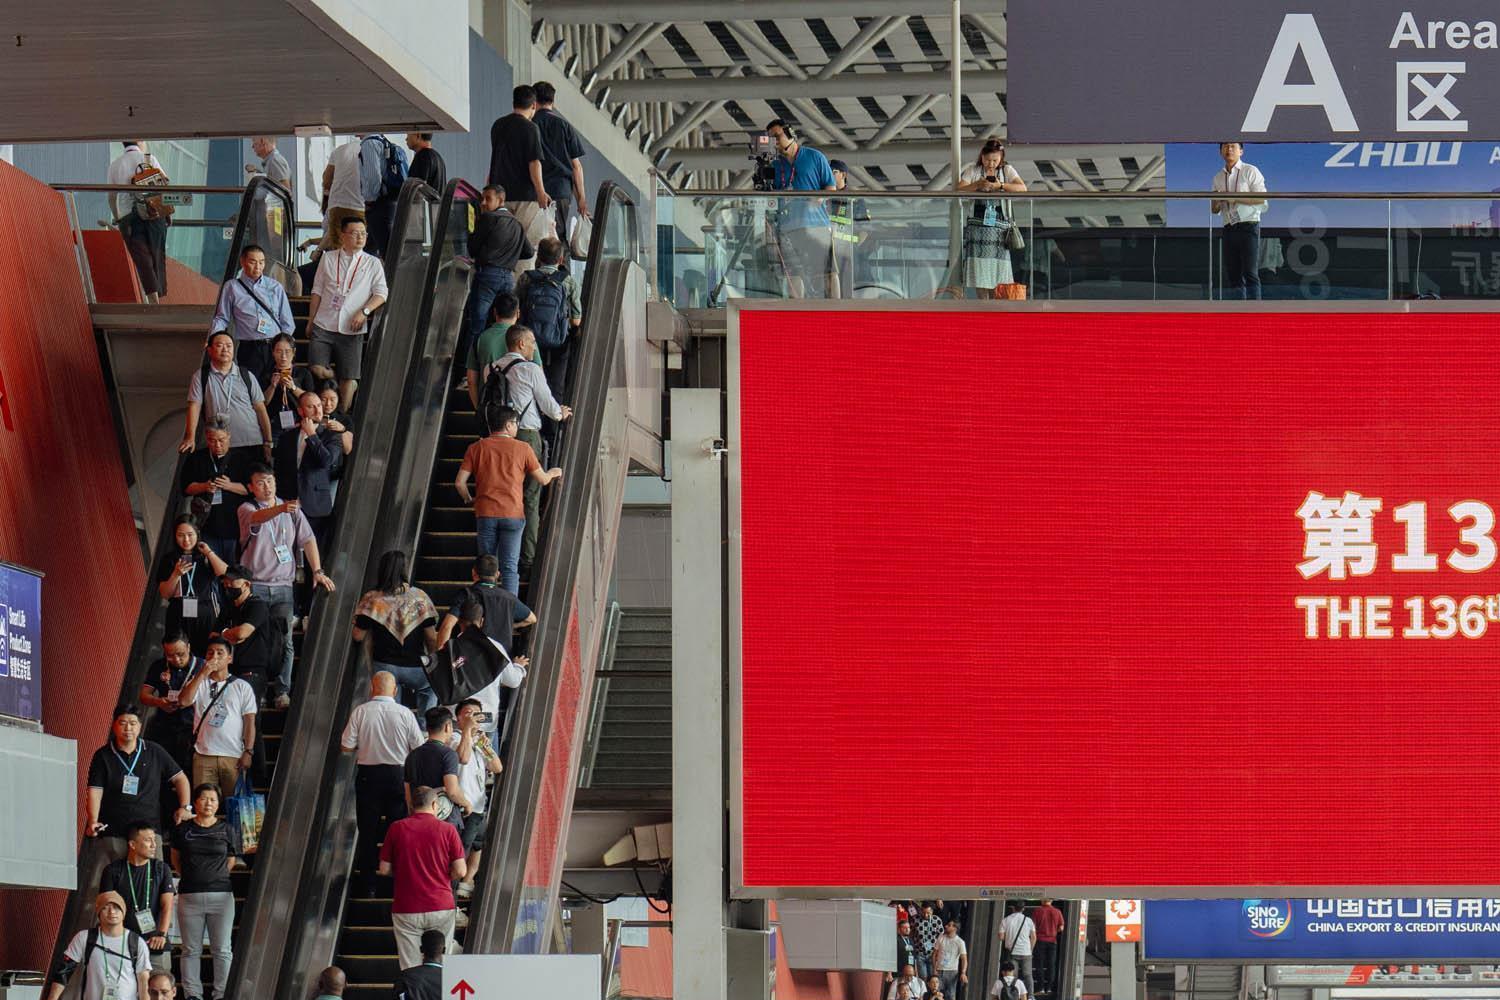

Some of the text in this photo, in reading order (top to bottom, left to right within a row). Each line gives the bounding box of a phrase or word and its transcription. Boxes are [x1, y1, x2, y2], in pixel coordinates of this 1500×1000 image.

[1389, 11, 1498, 49] Area
[1241, 13, 1360, 132] A
[1396, 62, 1468, 132] 区
[1324, 142, 1463, 168] ZHOU
[1297, 596, 1393, 639] THE
[1251, 918, 1284, 929] SURE
[1307, 922, 1344, 933] CHINA
[1347, 922, 1391, 933] EXPORT
[1393, 922, 1403, 933] &
[1405, 922, 1446, 933] CREDIT
